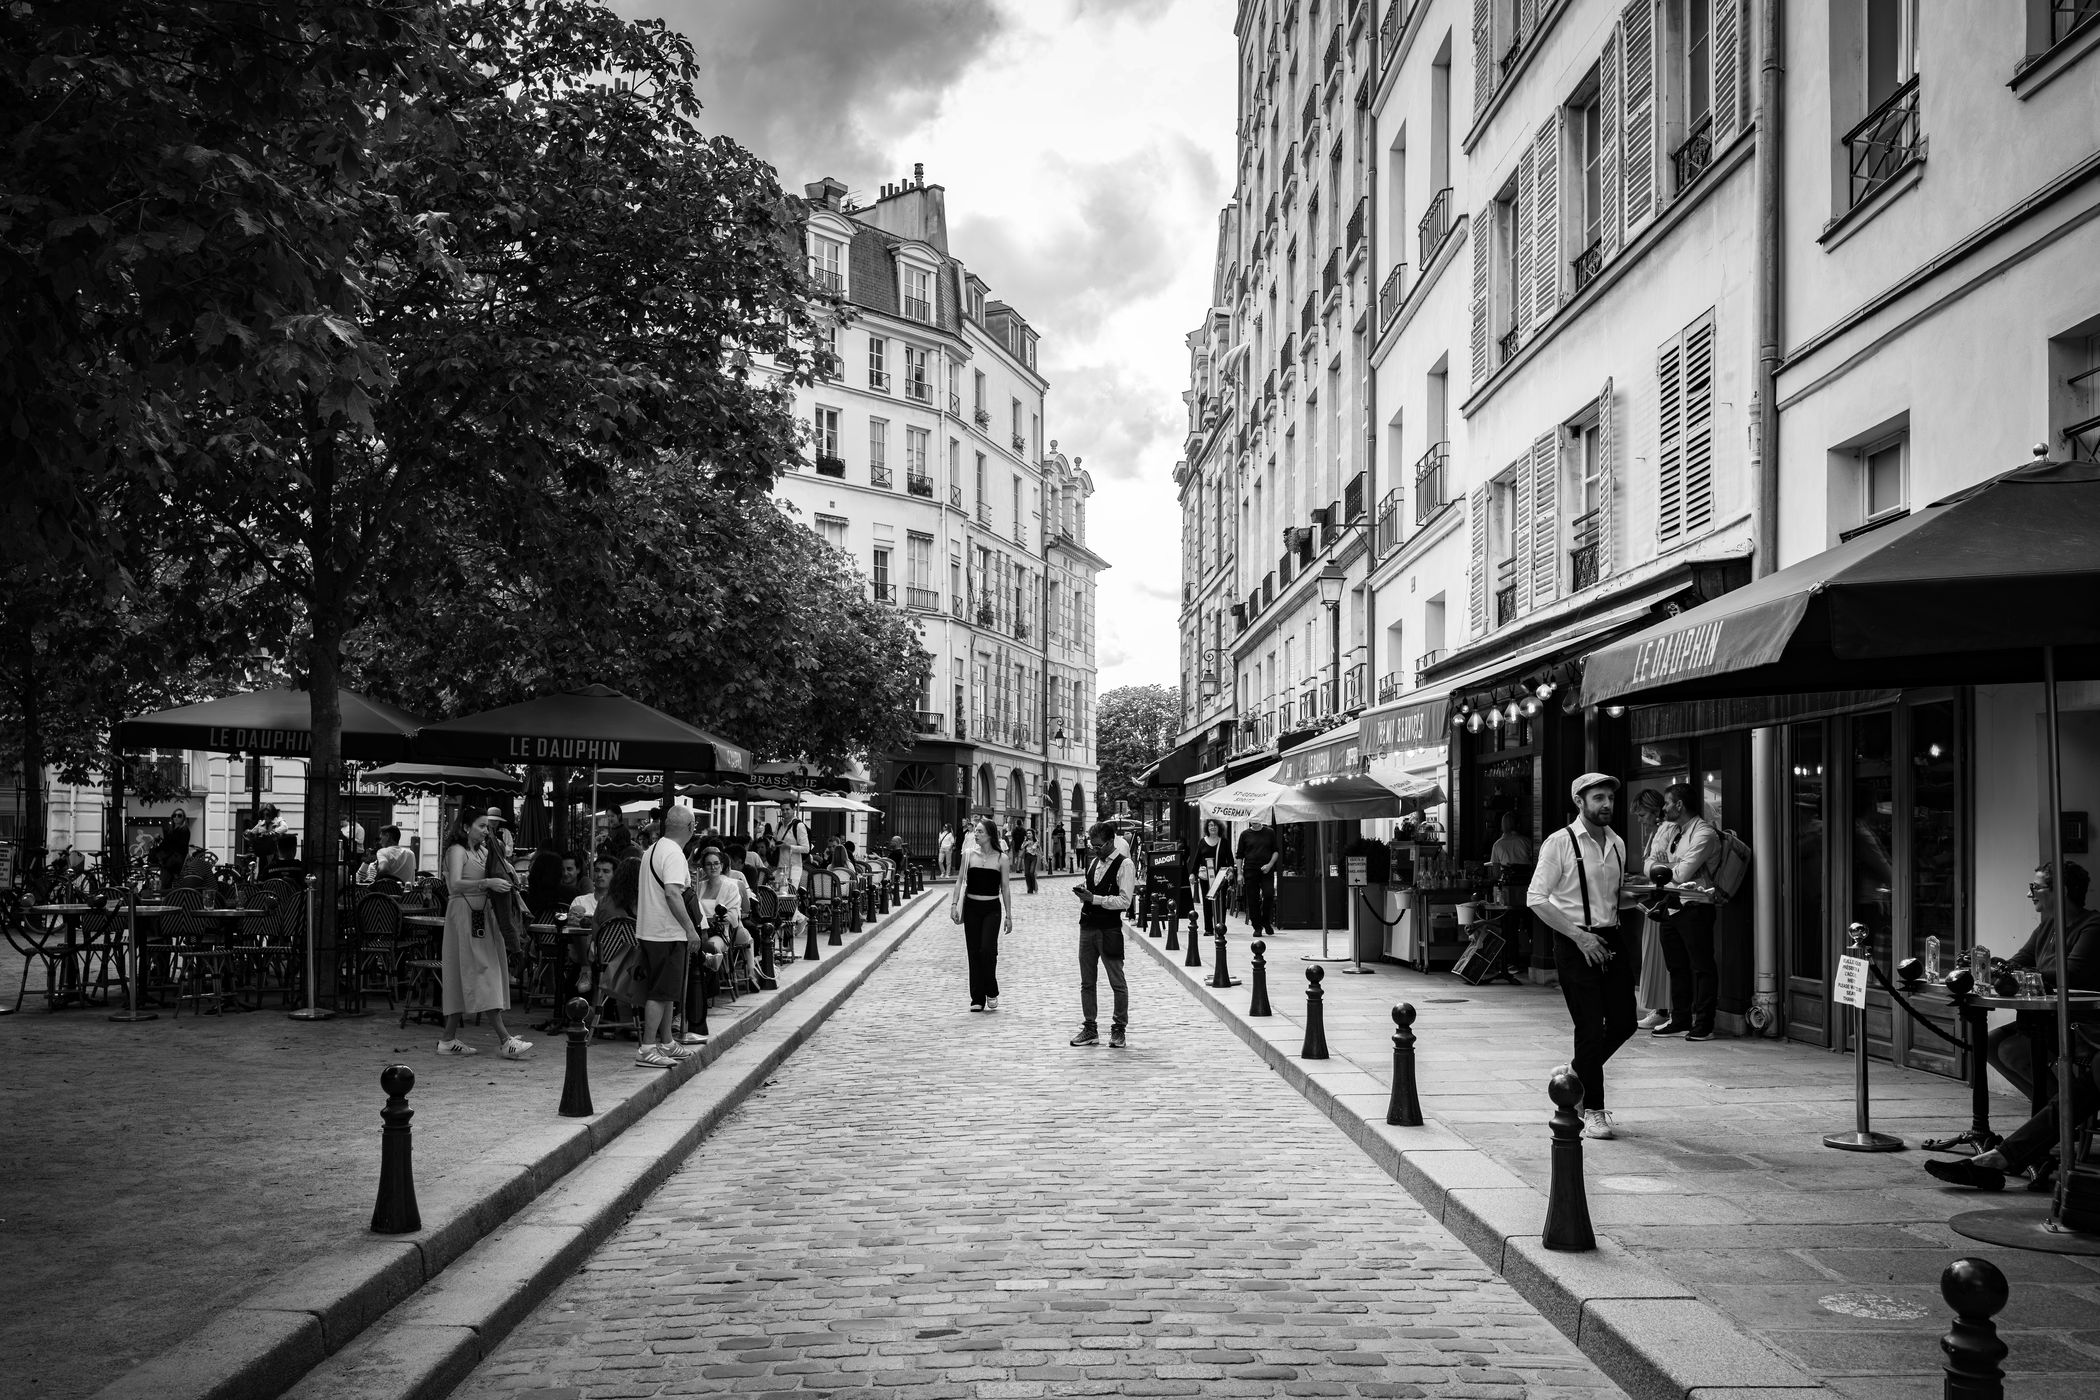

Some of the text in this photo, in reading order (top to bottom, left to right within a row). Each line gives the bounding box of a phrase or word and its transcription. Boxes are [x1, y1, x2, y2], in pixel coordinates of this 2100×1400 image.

[1632, 620, 1724, 684] LE DAUPHIN
[209, 727, 230, 747] LE
[510, 736, 620, 761] LE DAUPHIN
[750, 774, 817, 788] BRASSIE
